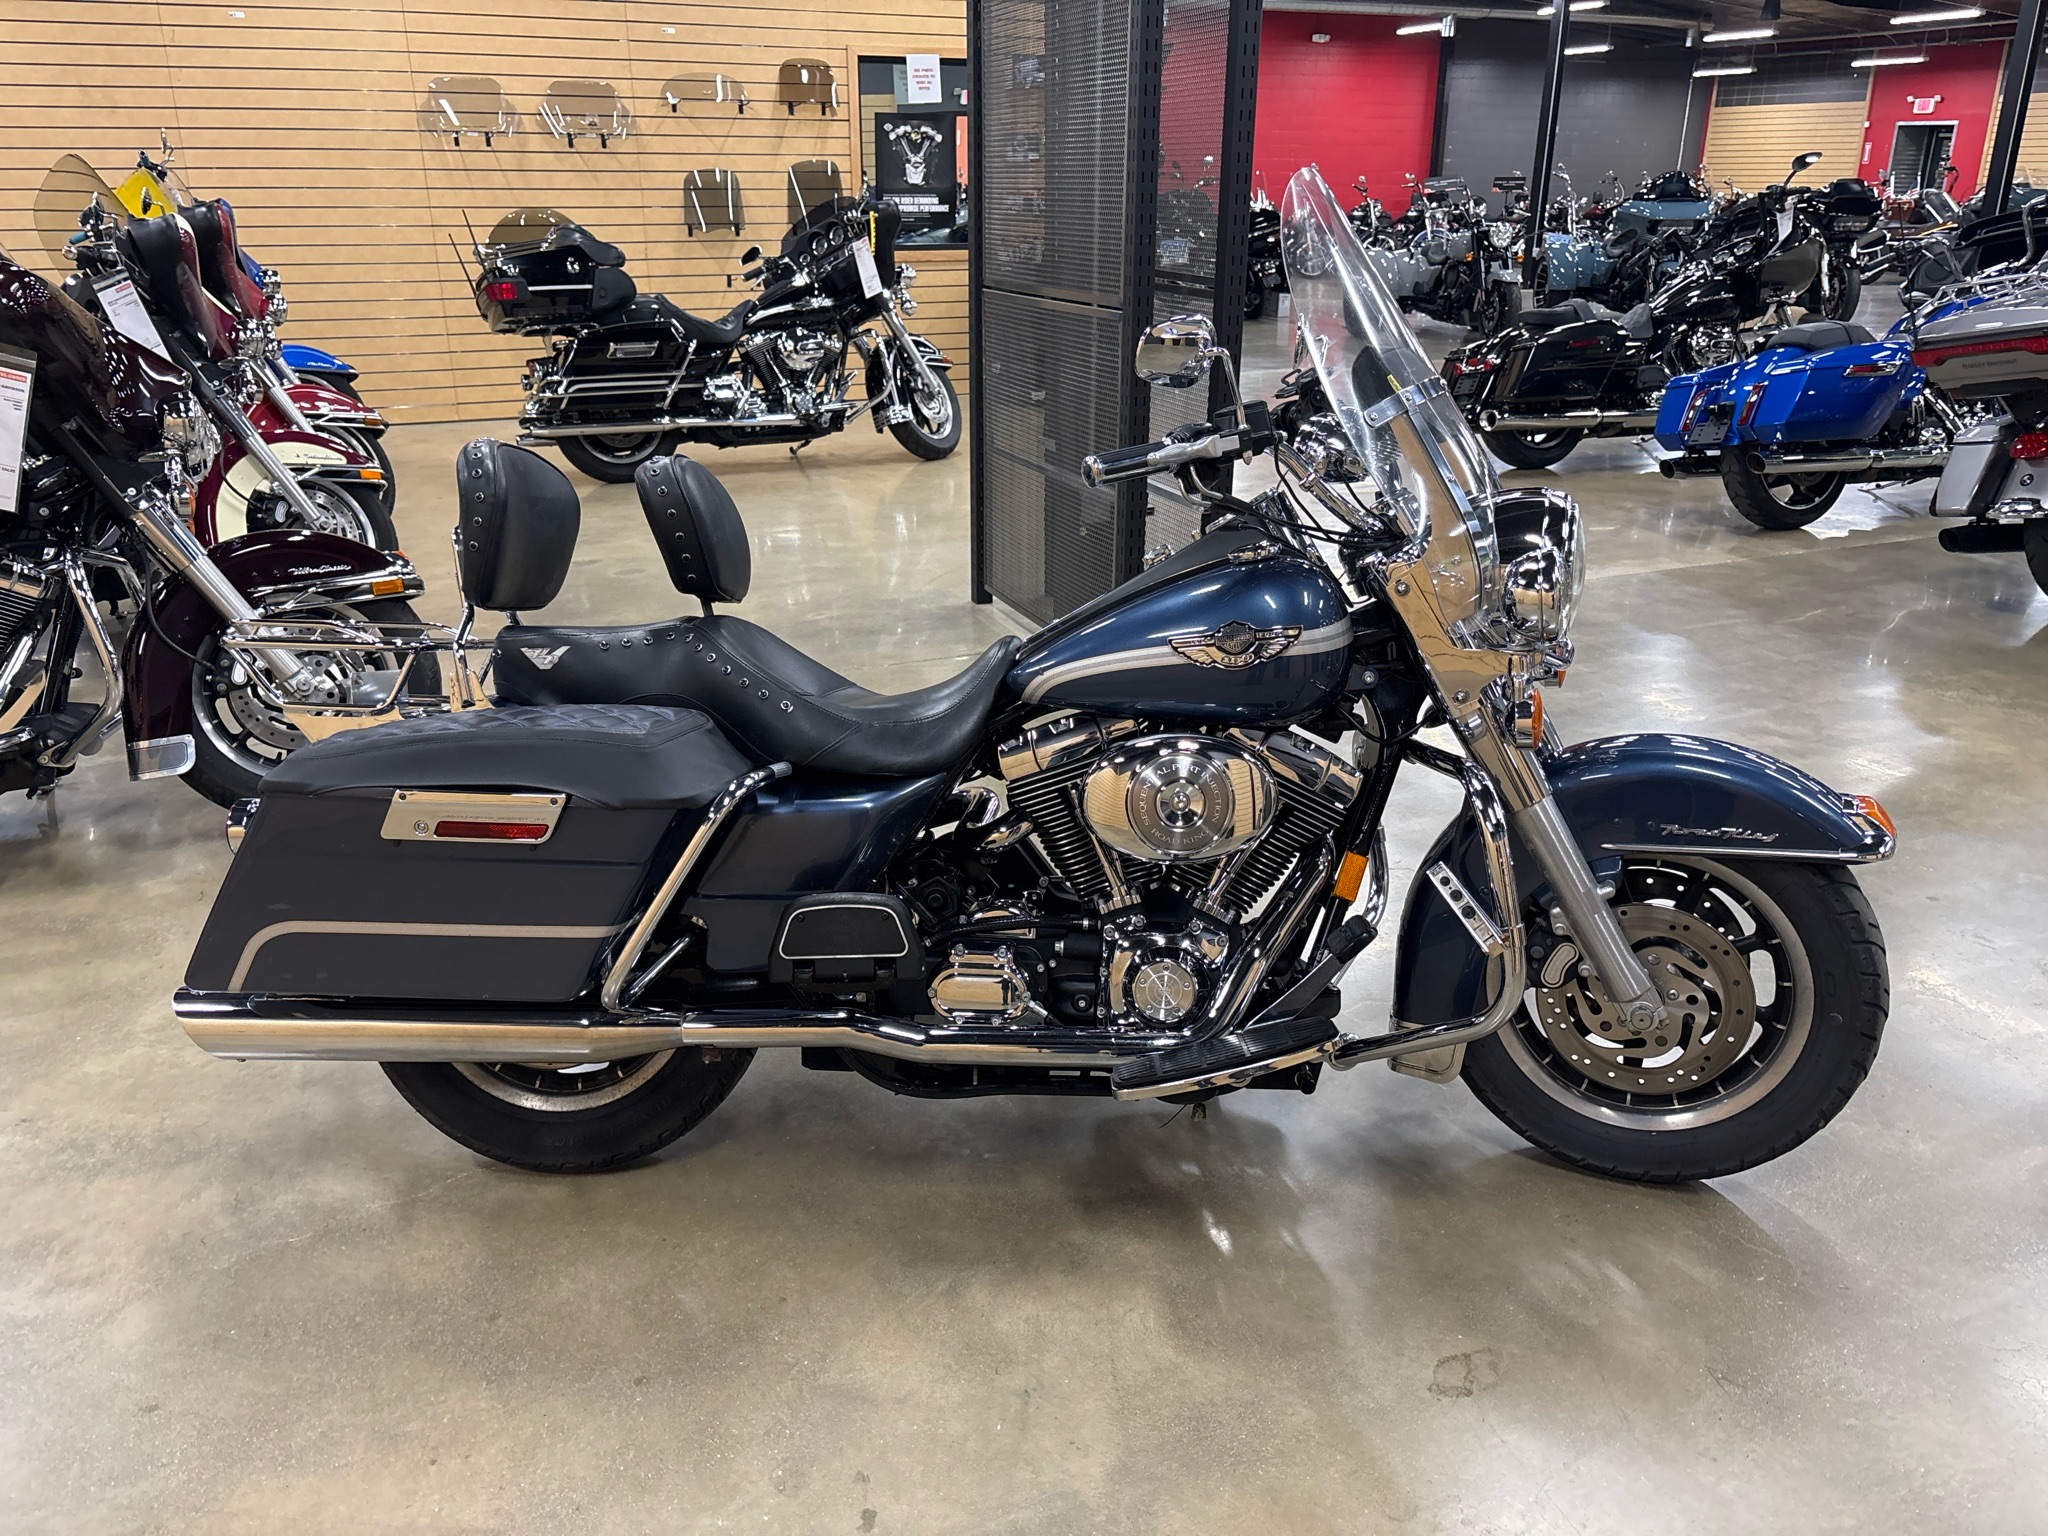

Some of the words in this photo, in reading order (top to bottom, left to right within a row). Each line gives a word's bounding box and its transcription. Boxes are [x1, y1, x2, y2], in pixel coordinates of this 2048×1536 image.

[900, 196, 914, 204] RIDER
[914, 196, 940, 204] DEMANDING
[920, 204, 950, 212] PERFORMANCE
[1138, 766, 1171, 826] SEQUENTAL
[1201, 772, 1222, 823] INJECTION
[1151, 828, 1180, 844] ROAD
[1183, 828, 1209, 844] KING
[1660, 824, 1720, 837] Road
[1720, 827, 1780, 842] King
